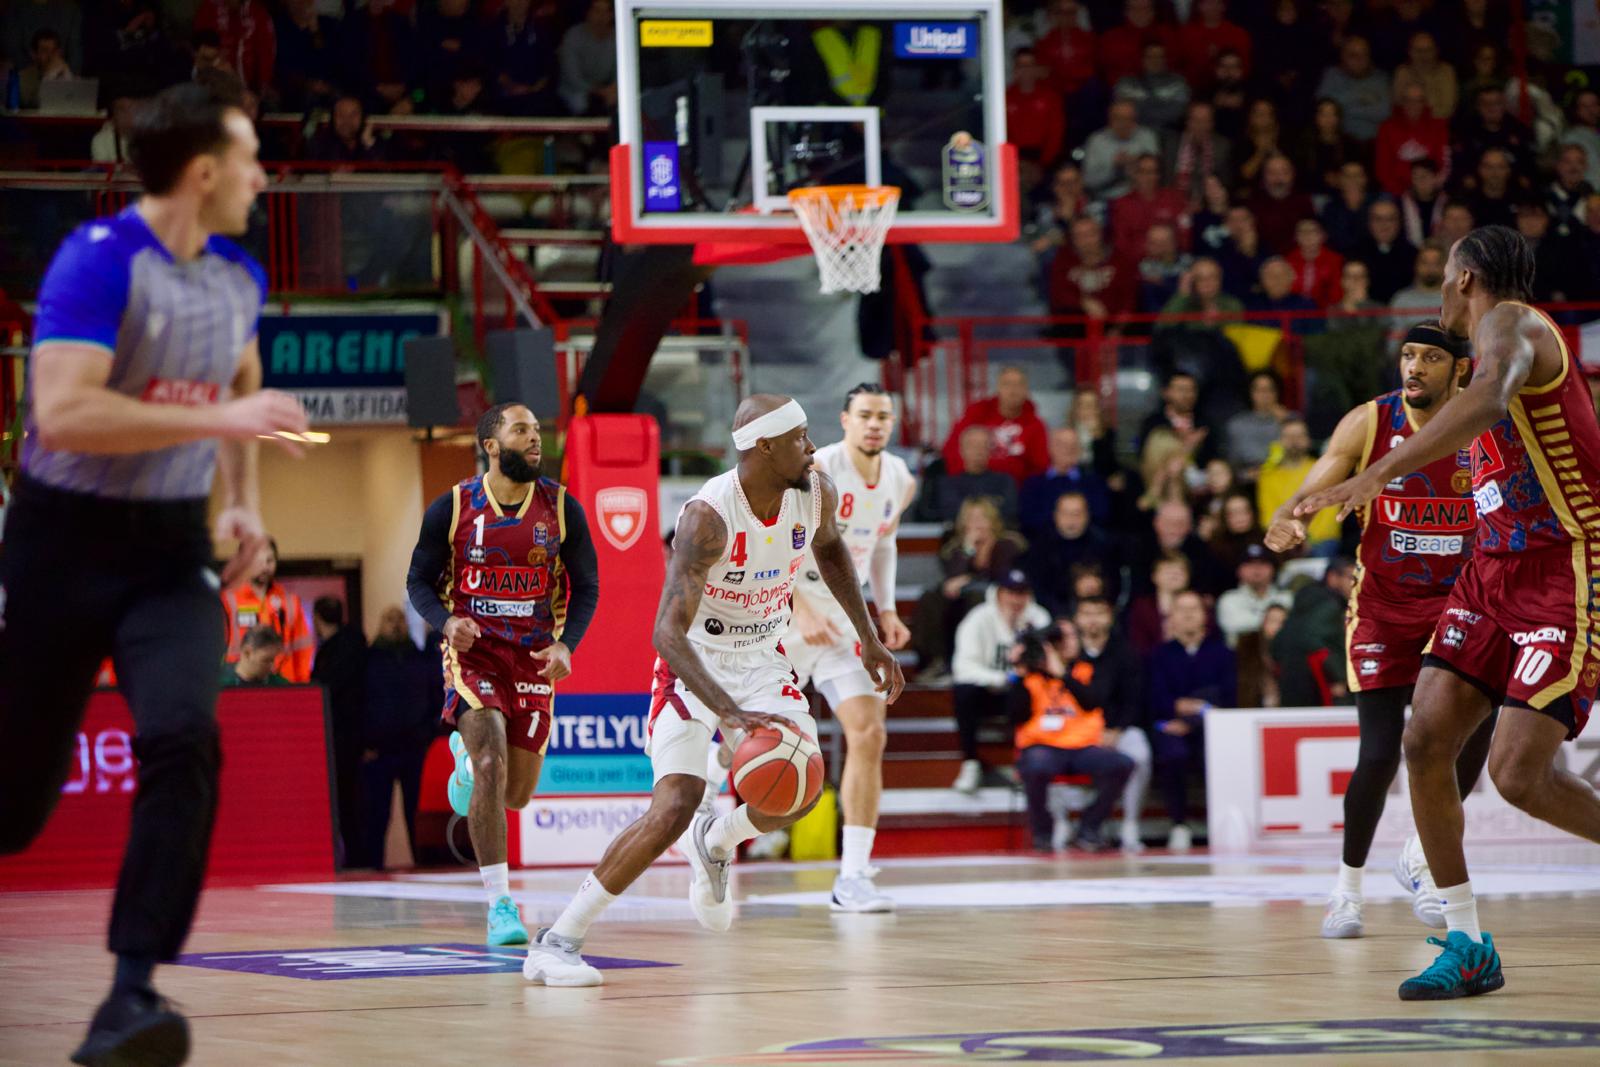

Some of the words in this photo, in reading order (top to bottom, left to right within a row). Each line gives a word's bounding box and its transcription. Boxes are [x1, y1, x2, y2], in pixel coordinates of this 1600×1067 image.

[840, 493, 853, 519] 8
[1384, 500, 1469, 525] UMANA
[473, 513, 485, 546] 1
[1393, 534, 1461, 551] RBcare
[730, 531, 748, 567] 4
[467, 569, 541, 592] UMANA
[1513, 646, 1553, 685] 10
[527, 710, 540, 738] 1
